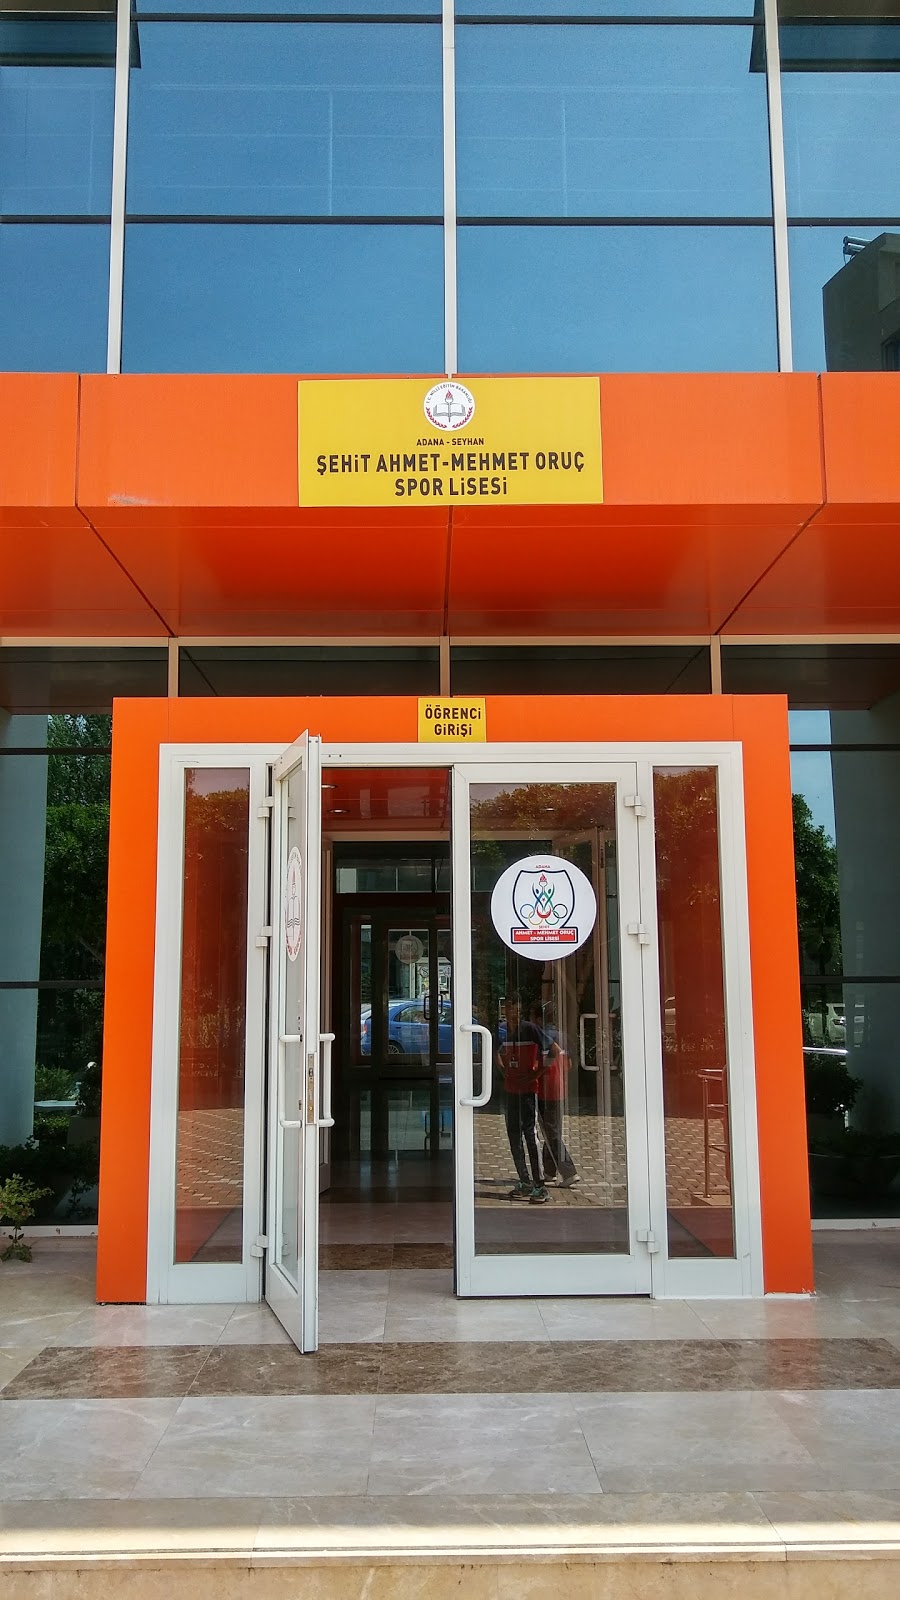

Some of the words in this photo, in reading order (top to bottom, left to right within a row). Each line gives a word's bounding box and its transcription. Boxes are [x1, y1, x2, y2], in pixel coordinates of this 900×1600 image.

[416, 438, 444, 446] ADANA
[452, 438, 484, 446] SEYHAN
[535, 451, 585, 472] ORUÇ
[395, 478, 444, 496] SPOR
